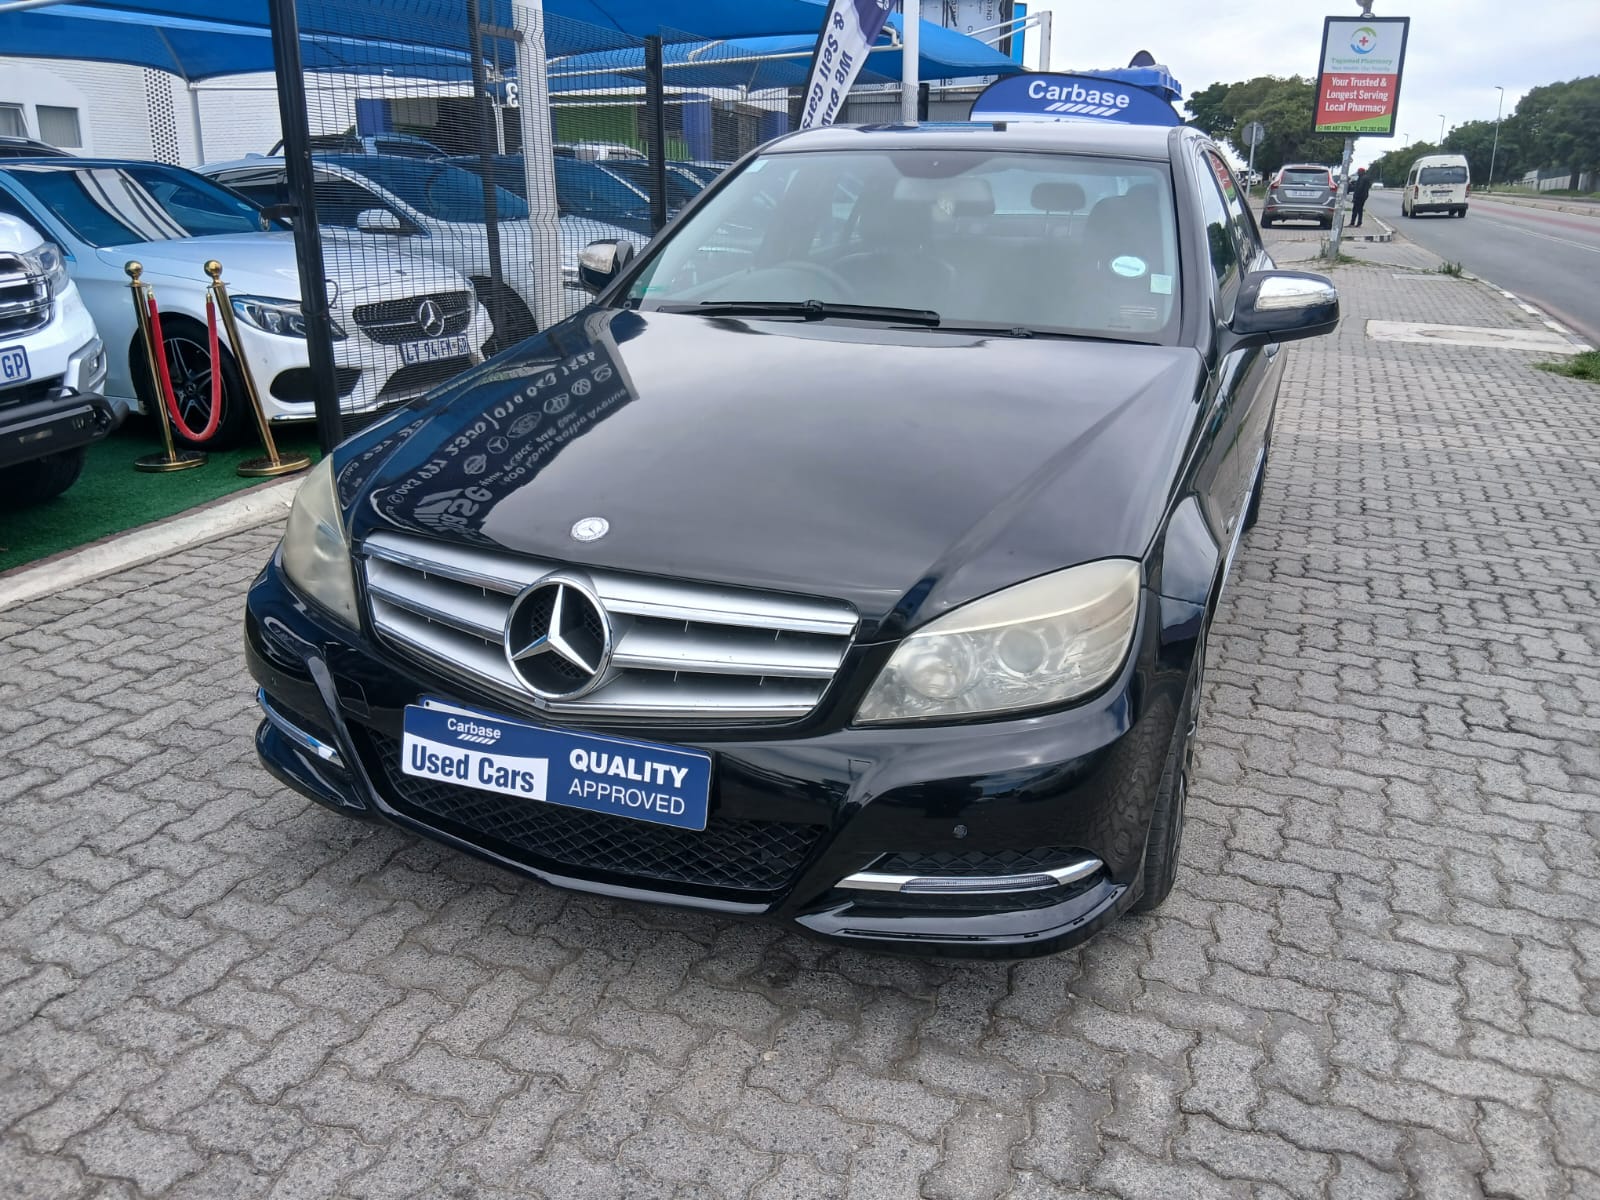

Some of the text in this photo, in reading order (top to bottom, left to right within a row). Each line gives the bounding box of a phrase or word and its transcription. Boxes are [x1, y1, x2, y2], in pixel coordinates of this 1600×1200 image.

[802, 11, 845, 130] & Sell Cars
[835, 49, 853, 86] We
[1331, 76, 1387, 87] Your Trusted &
[1028, 80, 1130, 108] Carbase
[1326, 89, 1389, 102] Longest Serving
[1325, 102, 1386, 115] Local Pharmacy
[2, 352, 24, 378] GP
[446, 717, 502, 740] Carbase
[410, 742, 535, 794] Used Cars
[569, 748, 689, 789] QUALITY
[568, 777, 685, 816] APPROVED
